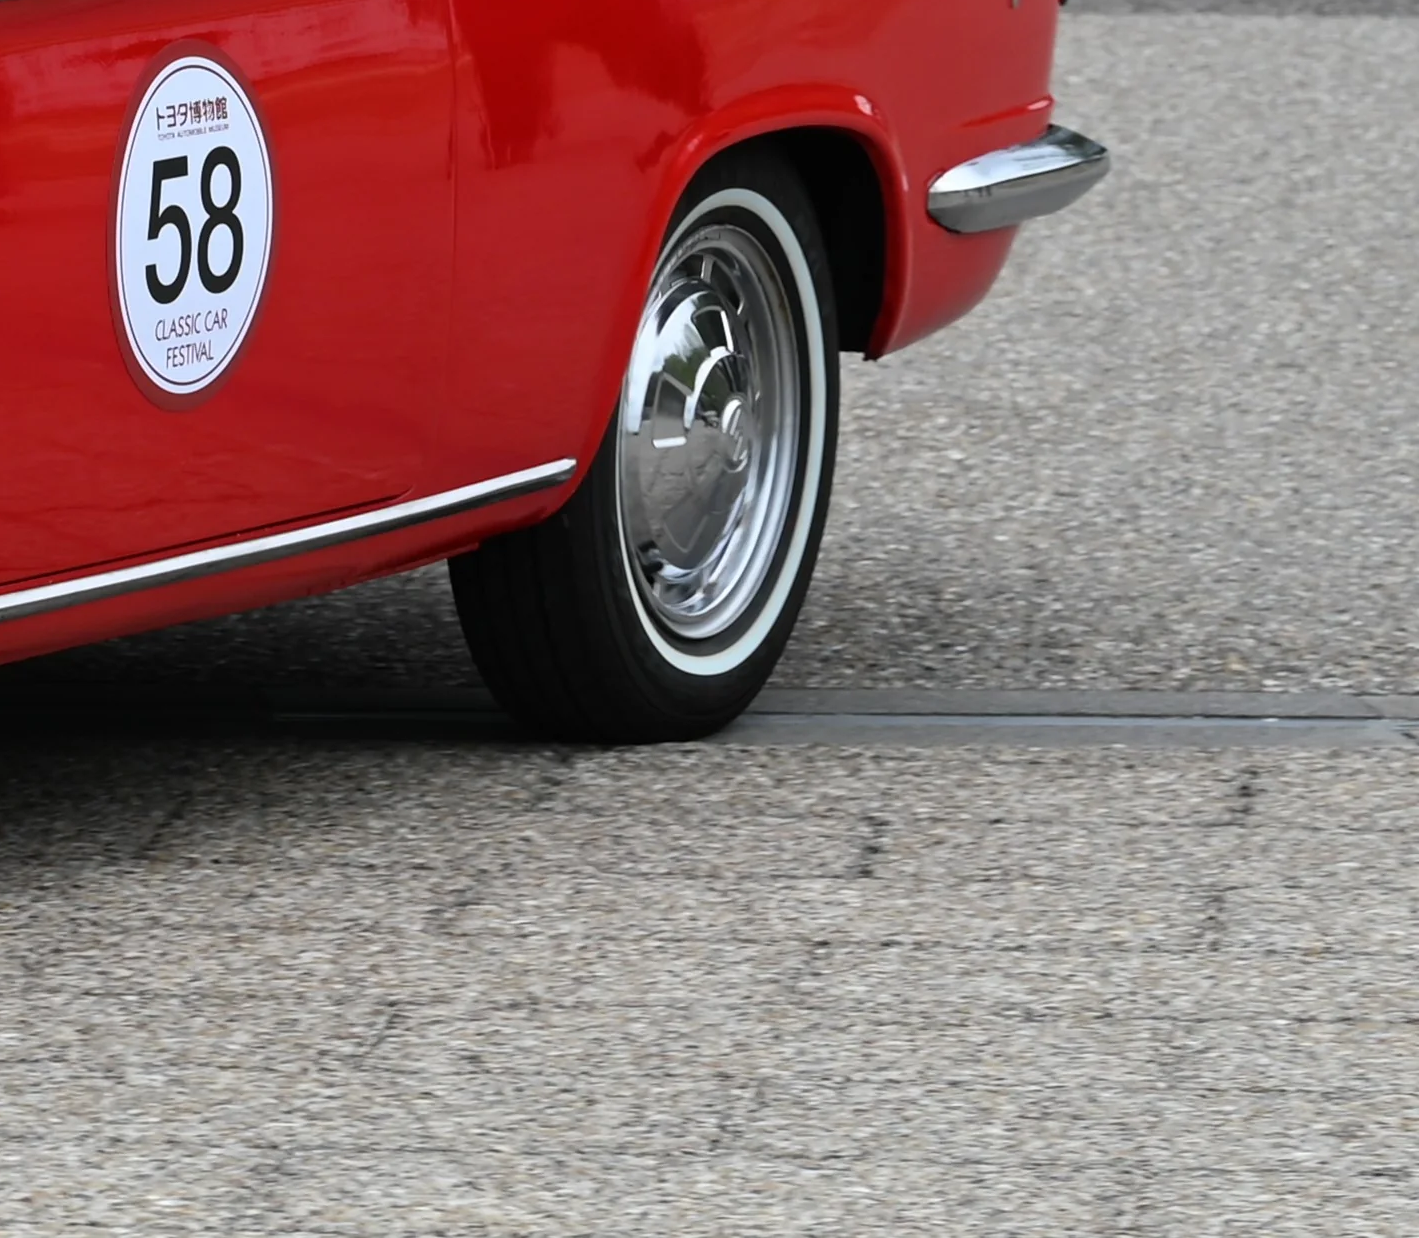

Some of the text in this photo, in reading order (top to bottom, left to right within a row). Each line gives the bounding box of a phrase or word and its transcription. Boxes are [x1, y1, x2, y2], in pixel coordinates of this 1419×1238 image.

[156, 97, 228, 130] トヨタ博物館
[145, 145, 244, 305] 58
[155, 307, 229, 342] CLASSIC CAR
[166, 339, 215, 370] FESTIVAL
